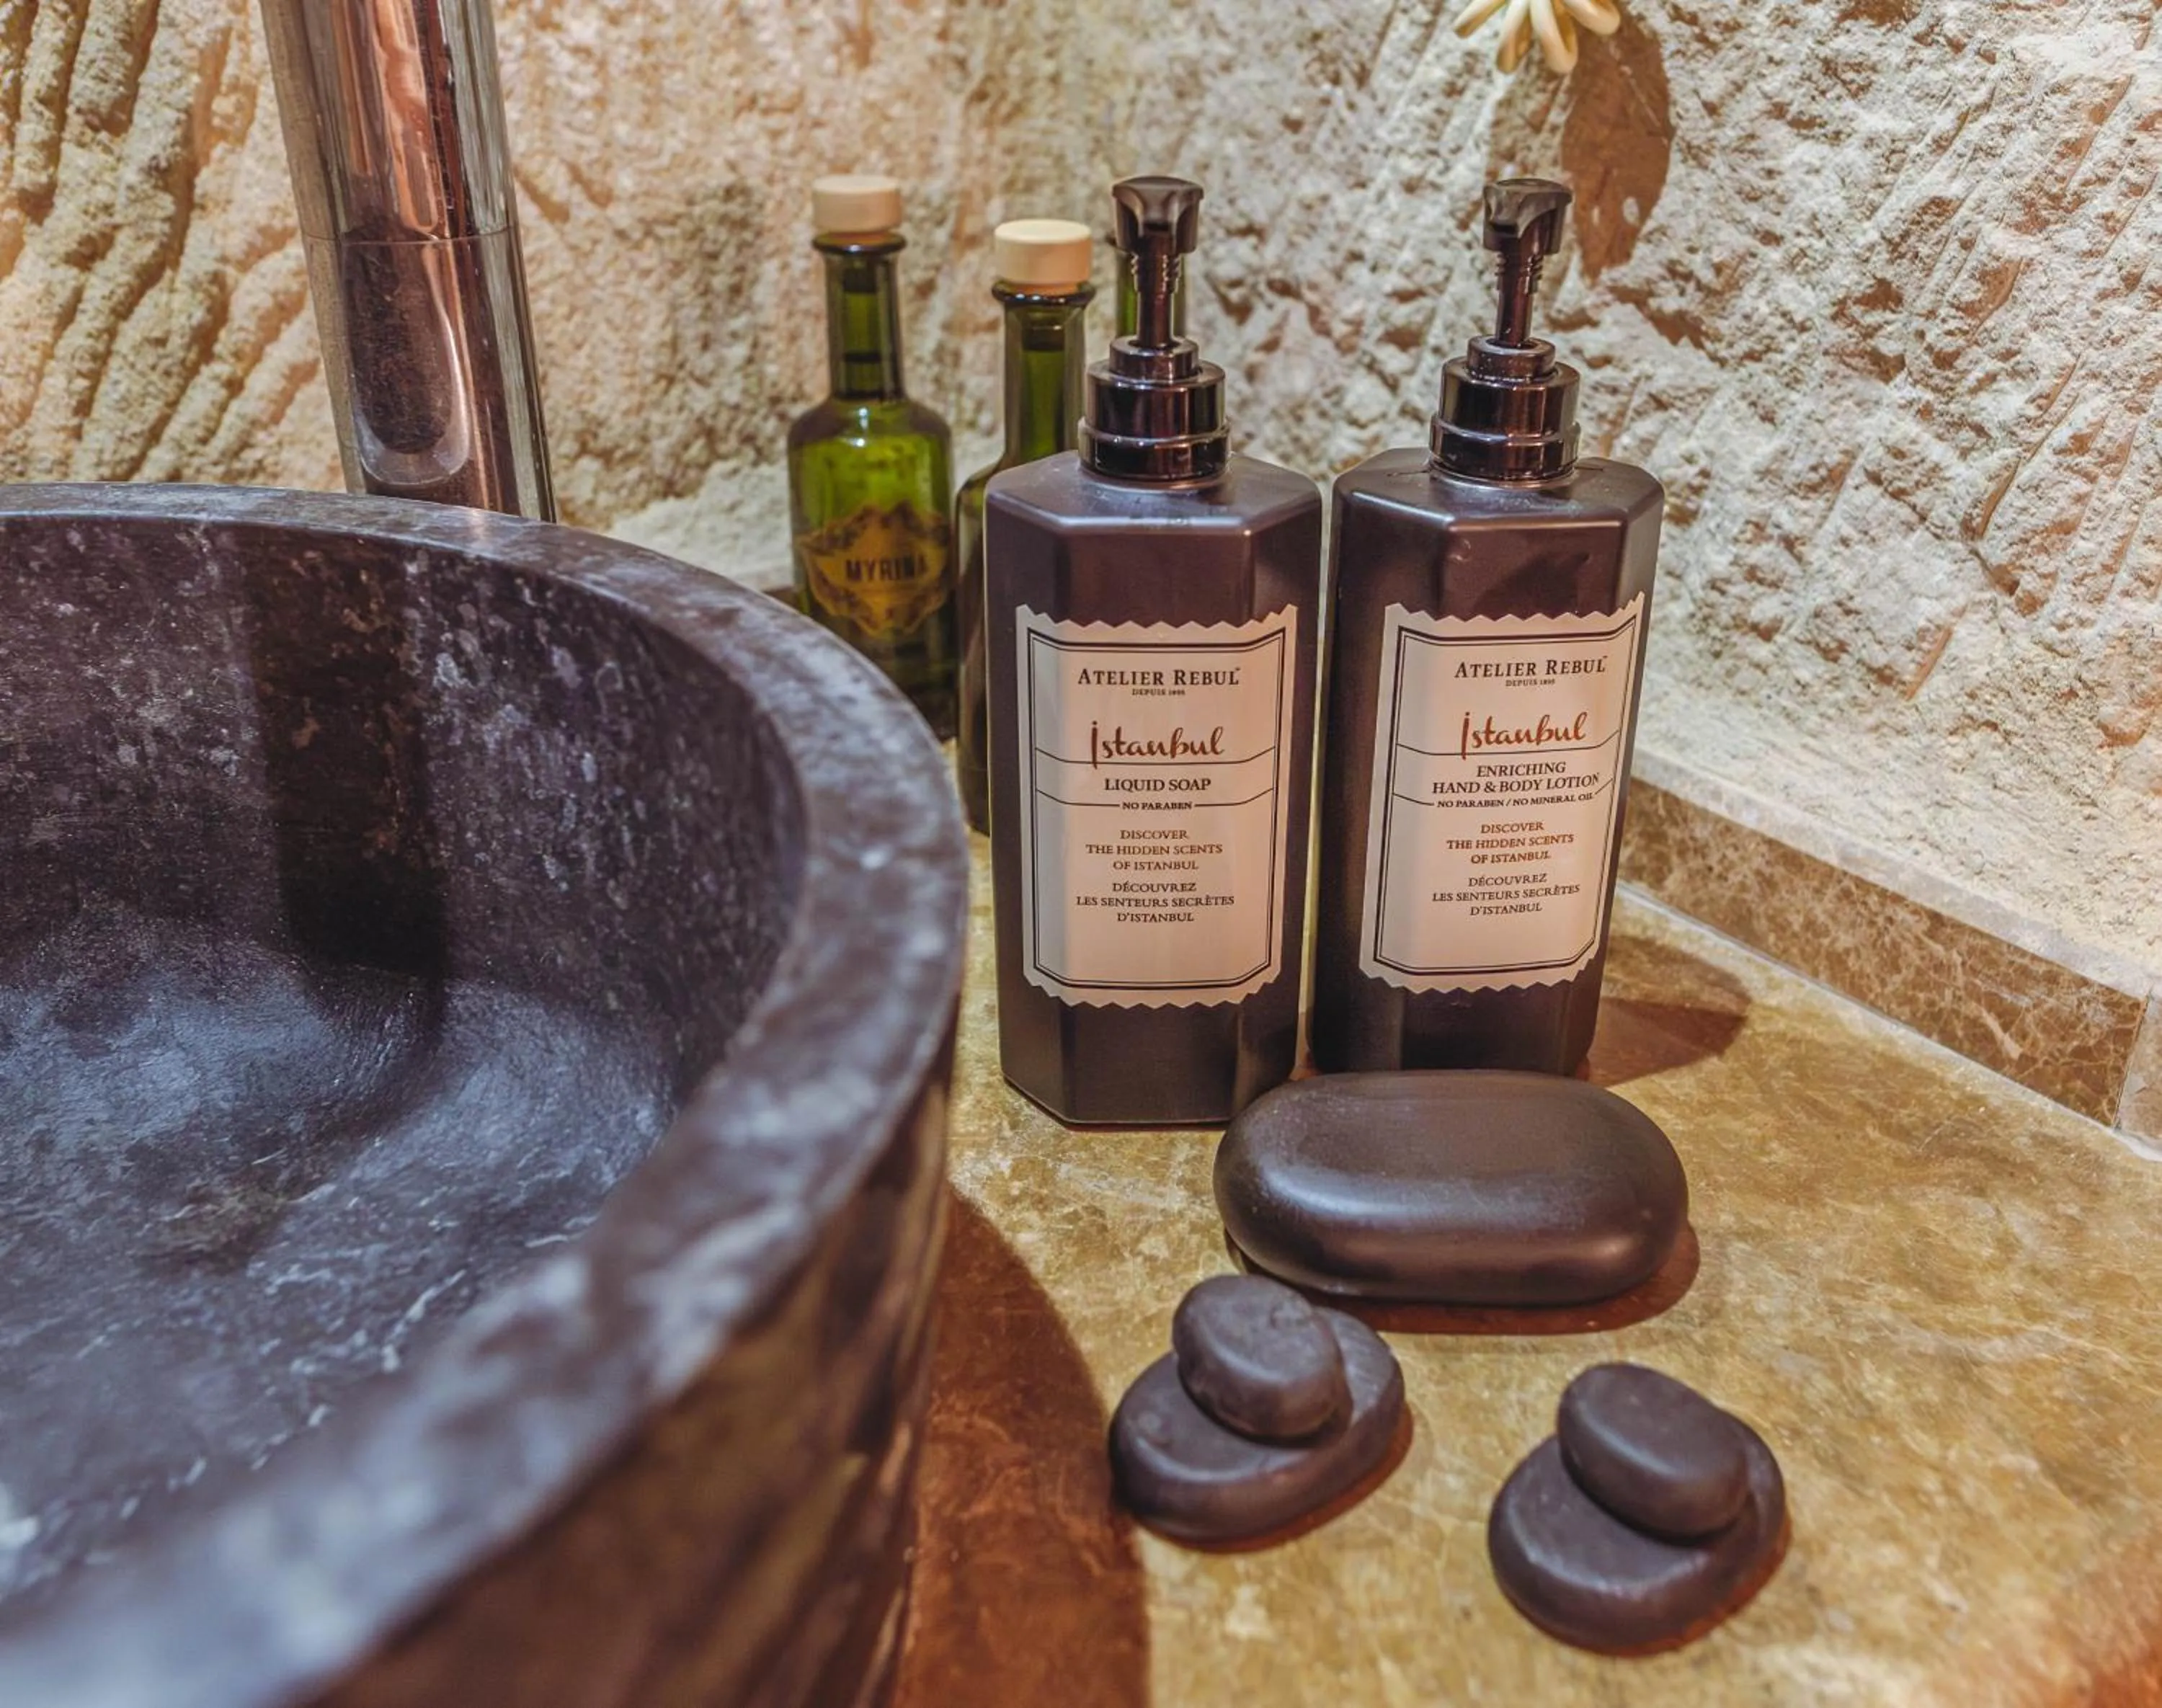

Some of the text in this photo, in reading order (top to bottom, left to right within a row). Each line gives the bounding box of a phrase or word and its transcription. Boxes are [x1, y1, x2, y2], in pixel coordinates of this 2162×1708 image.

[1454, 661, 1536, 678] ATELIER
[1077, 668, 1164, 686] ATELIER
[1477, 762, 1566, 778] ENRICHING
[1104, 778, 1211, 792] LIQUID SOAP
[1432, 773, 1600, 794] HAND & BODY LOTION
[1122, 801, 1193, 810] NO PARABEN
[1455, 798, 1504, 808] PARABEN
[1513, 798, 1529, 806] NO
[1530, 794, 1575, 804] MINERAL
[1578, 792, 1593, 802] OIL
[1120, 829, 1188, 840] DISCOVER
[1481, 822, 1544, 834] DISCOVER
[1446, 834, 1574, 850] THE HIDDEN SCENTS
[1085, 844, 1223, 855] THE HIDDEN SCENTS
[1470, 850, 1552, 864] OF ISTANBUL
[1113, 860, 1198, 871] OF ISTANBUL
[1112, 881, 1197, 893] DÉCOUVREZ
[1468, 873, 1547, 887] DÉCOUVREZ
[1077, 894, 1235, 907] LES SENTEURS SECRÈTES
[1432, 891, 1454, 902] LES
[1456, 889, 1520, 902] SENTEURS
[1469, 902, 1543, 916] D'ISTANBUL
[1117, 912, 1194, 922] D'ISTANBUL
